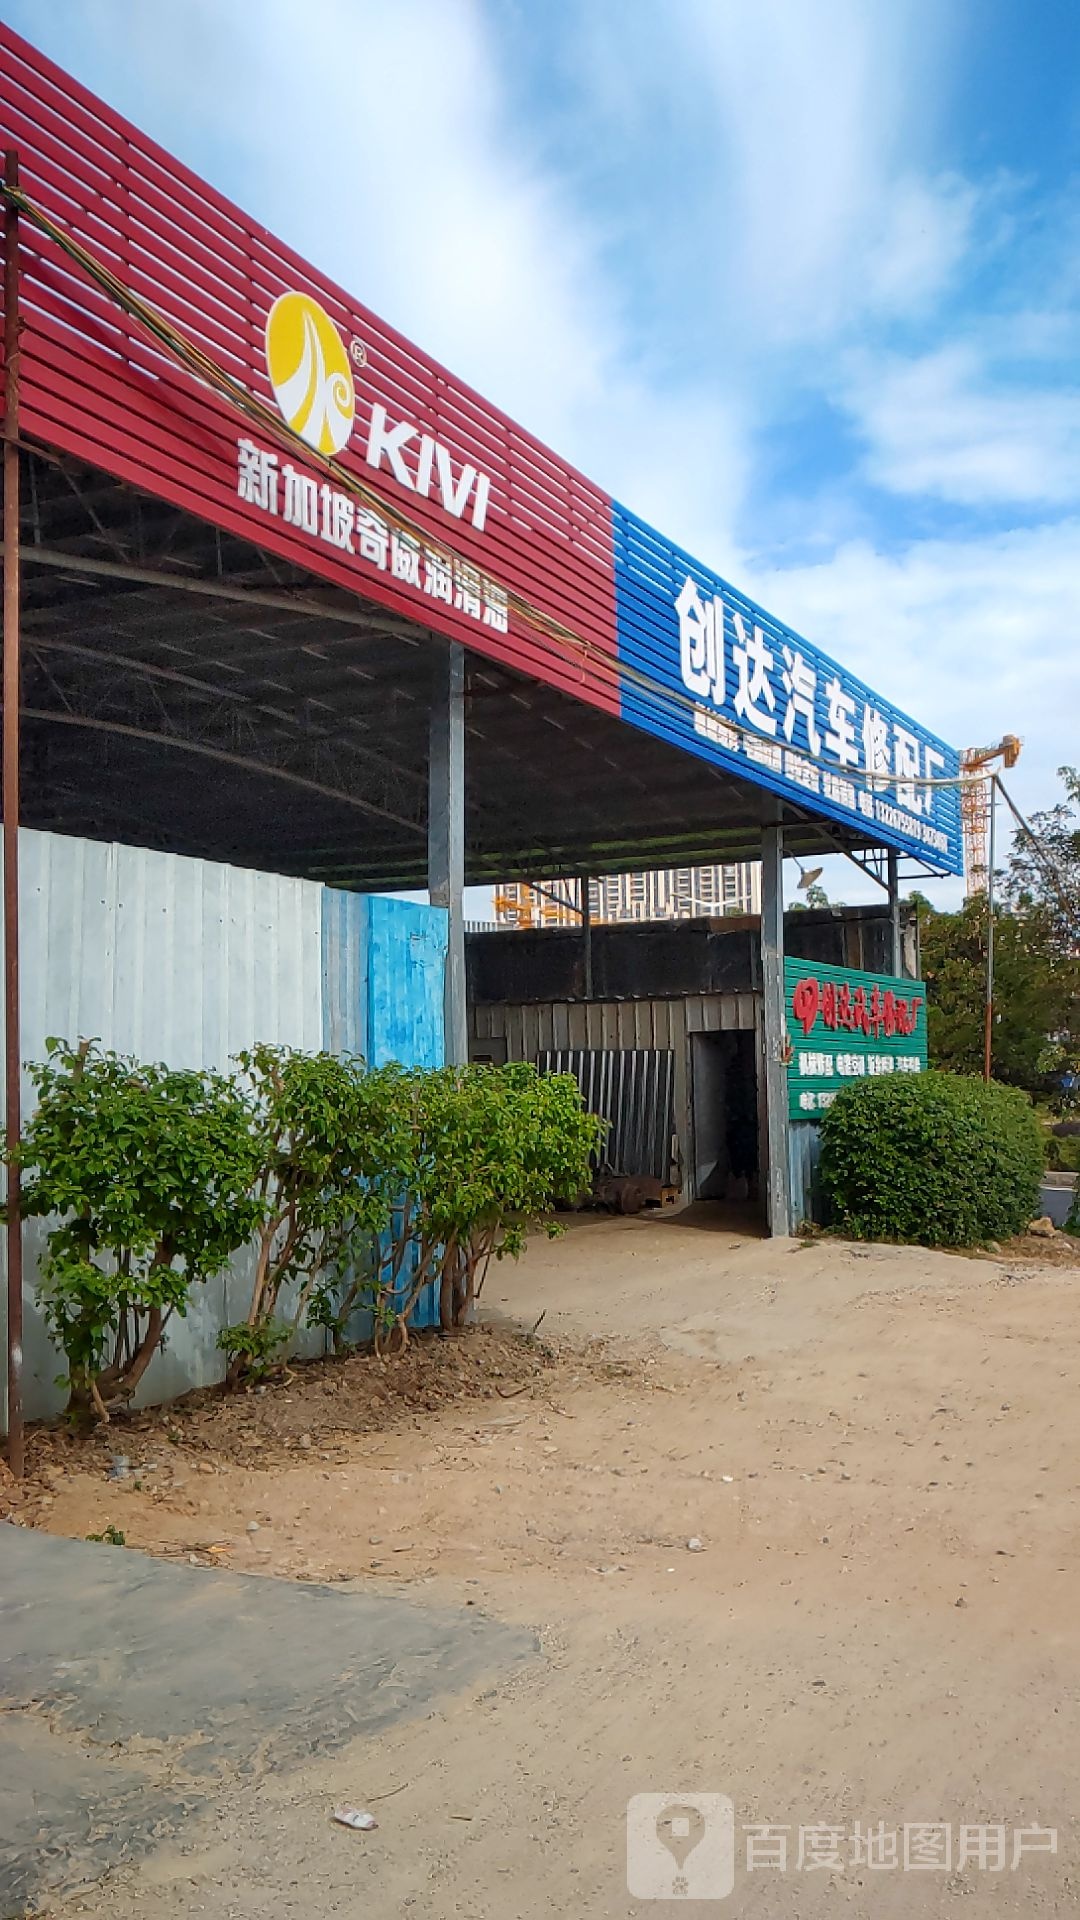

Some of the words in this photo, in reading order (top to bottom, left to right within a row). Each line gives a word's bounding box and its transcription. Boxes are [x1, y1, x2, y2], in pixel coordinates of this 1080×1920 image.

[366, 403, 491, 532] KIVI
[674, 576, 945, 815] 创达汽车修配厂
